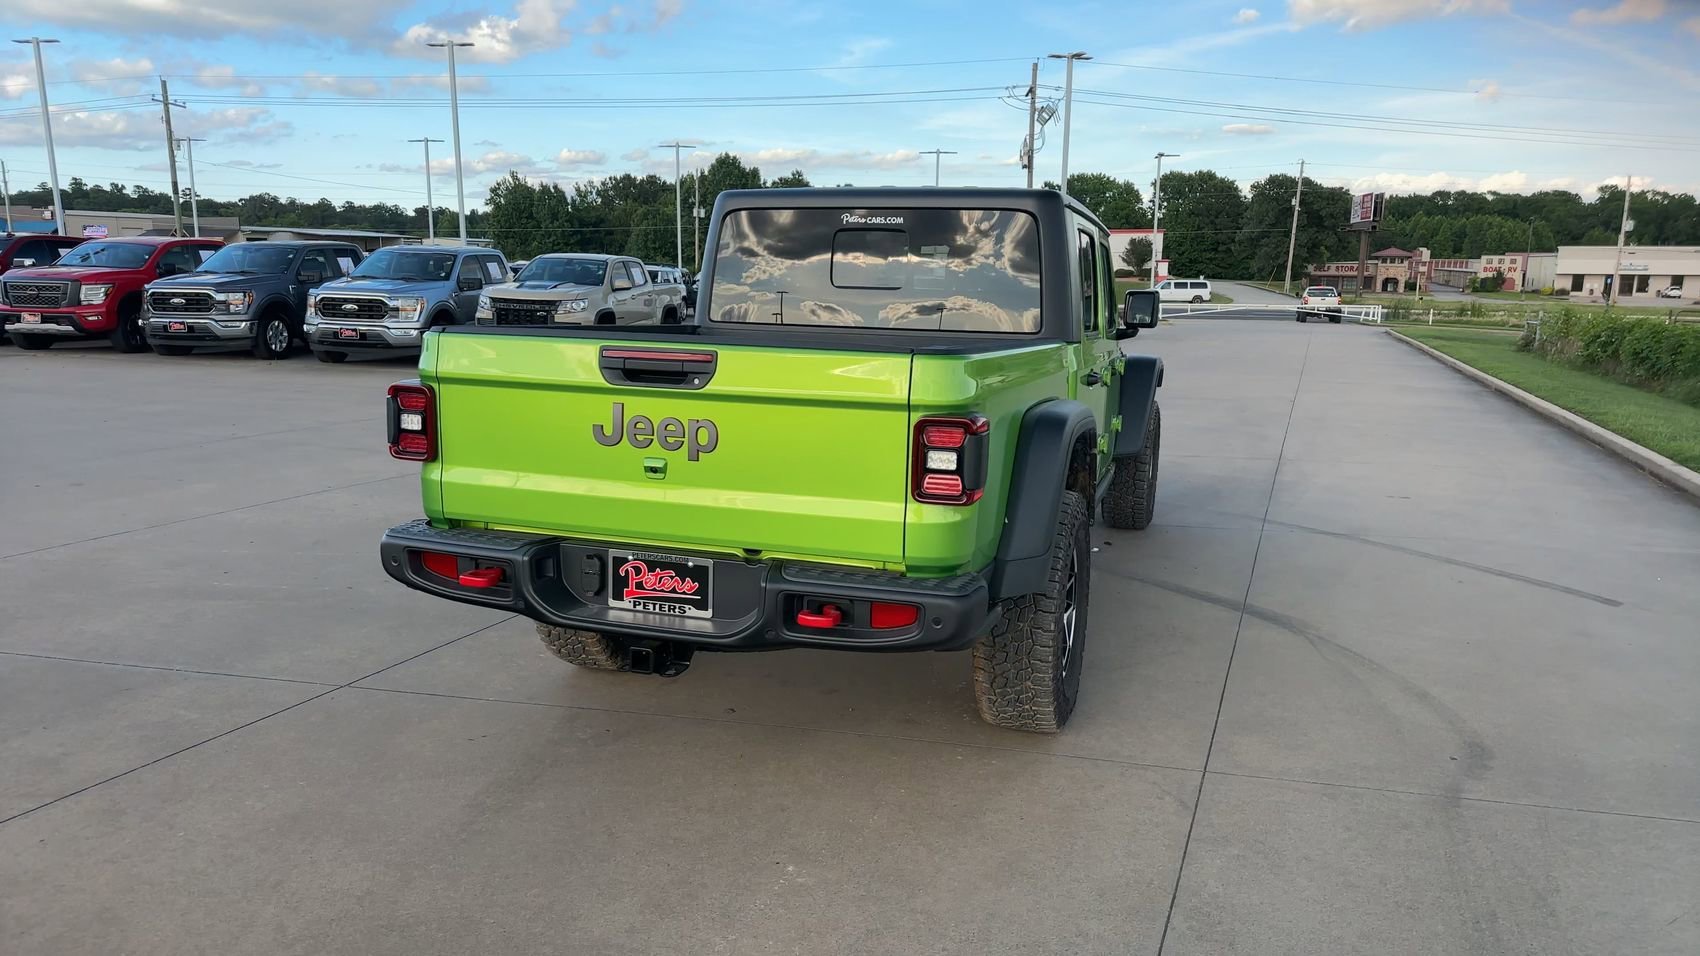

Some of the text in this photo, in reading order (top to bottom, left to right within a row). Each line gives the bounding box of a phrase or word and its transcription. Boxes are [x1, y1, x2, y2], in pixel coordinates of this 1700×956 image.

[1313, 265, 1370, 273] SELF STORAE
[592, 402, 719, 462] Jeep
[632, 551, 690, 563] PETERSCARS.COM
[619, 561, 700, 597] Peters
[632, 600, 688, 615] PETERS
